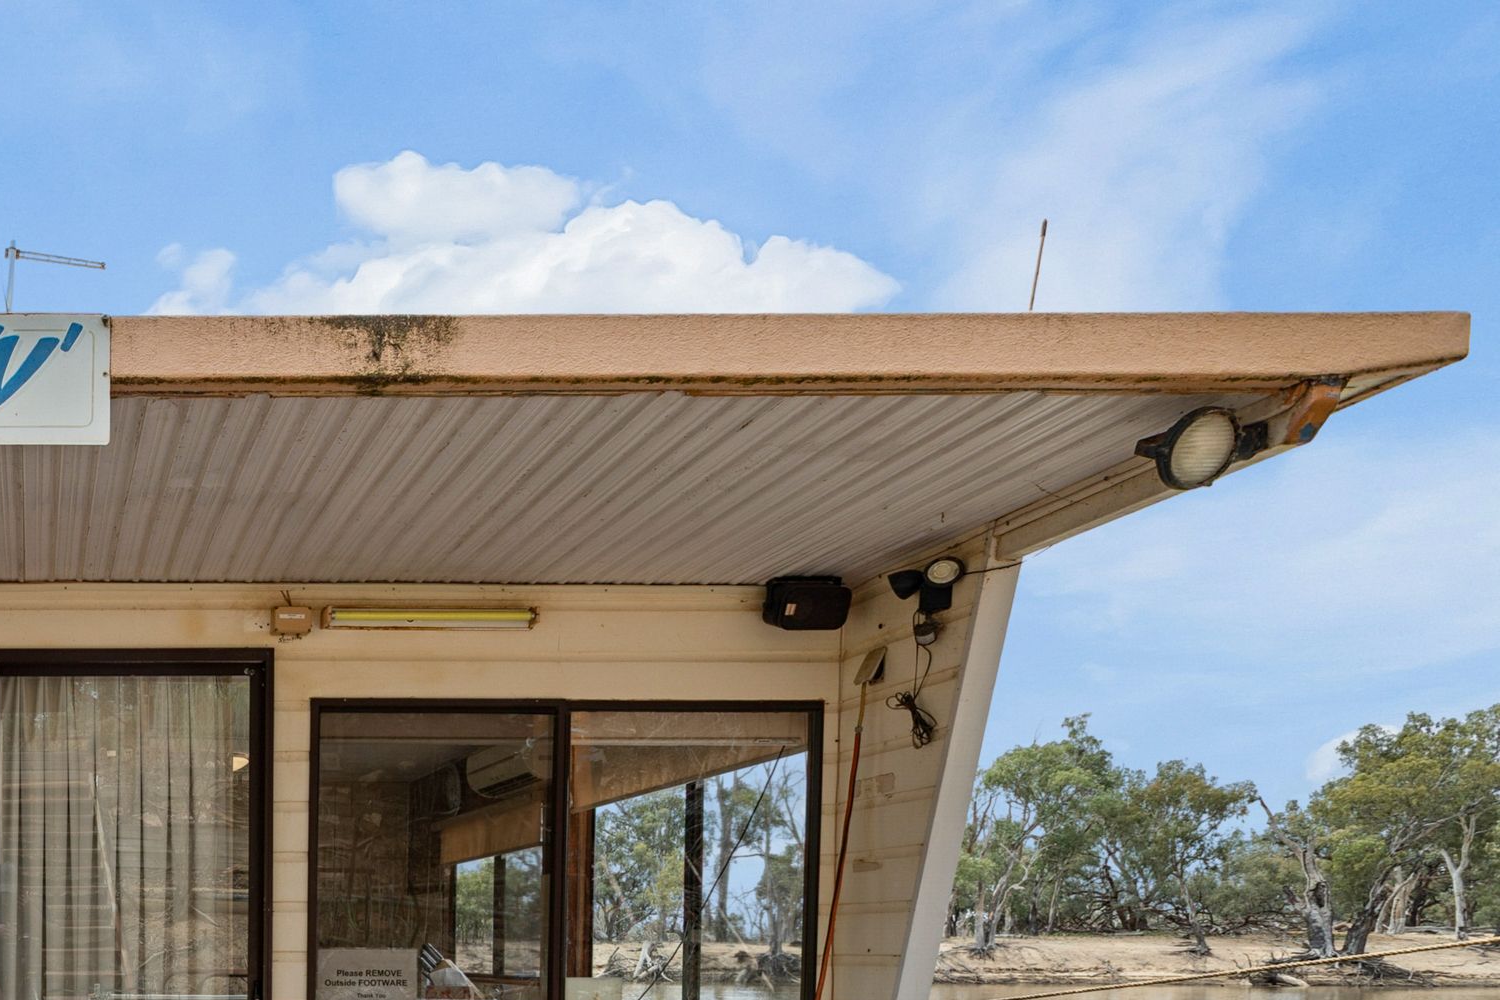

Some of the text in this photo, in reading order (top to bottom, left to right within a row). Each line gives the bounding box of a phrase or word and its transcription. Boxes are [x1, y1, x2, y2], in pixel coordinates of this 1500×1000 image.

[336, 969, 402, 977] Please REMOVE
[324, 979, 408, 987] Outside FOOTWARE
